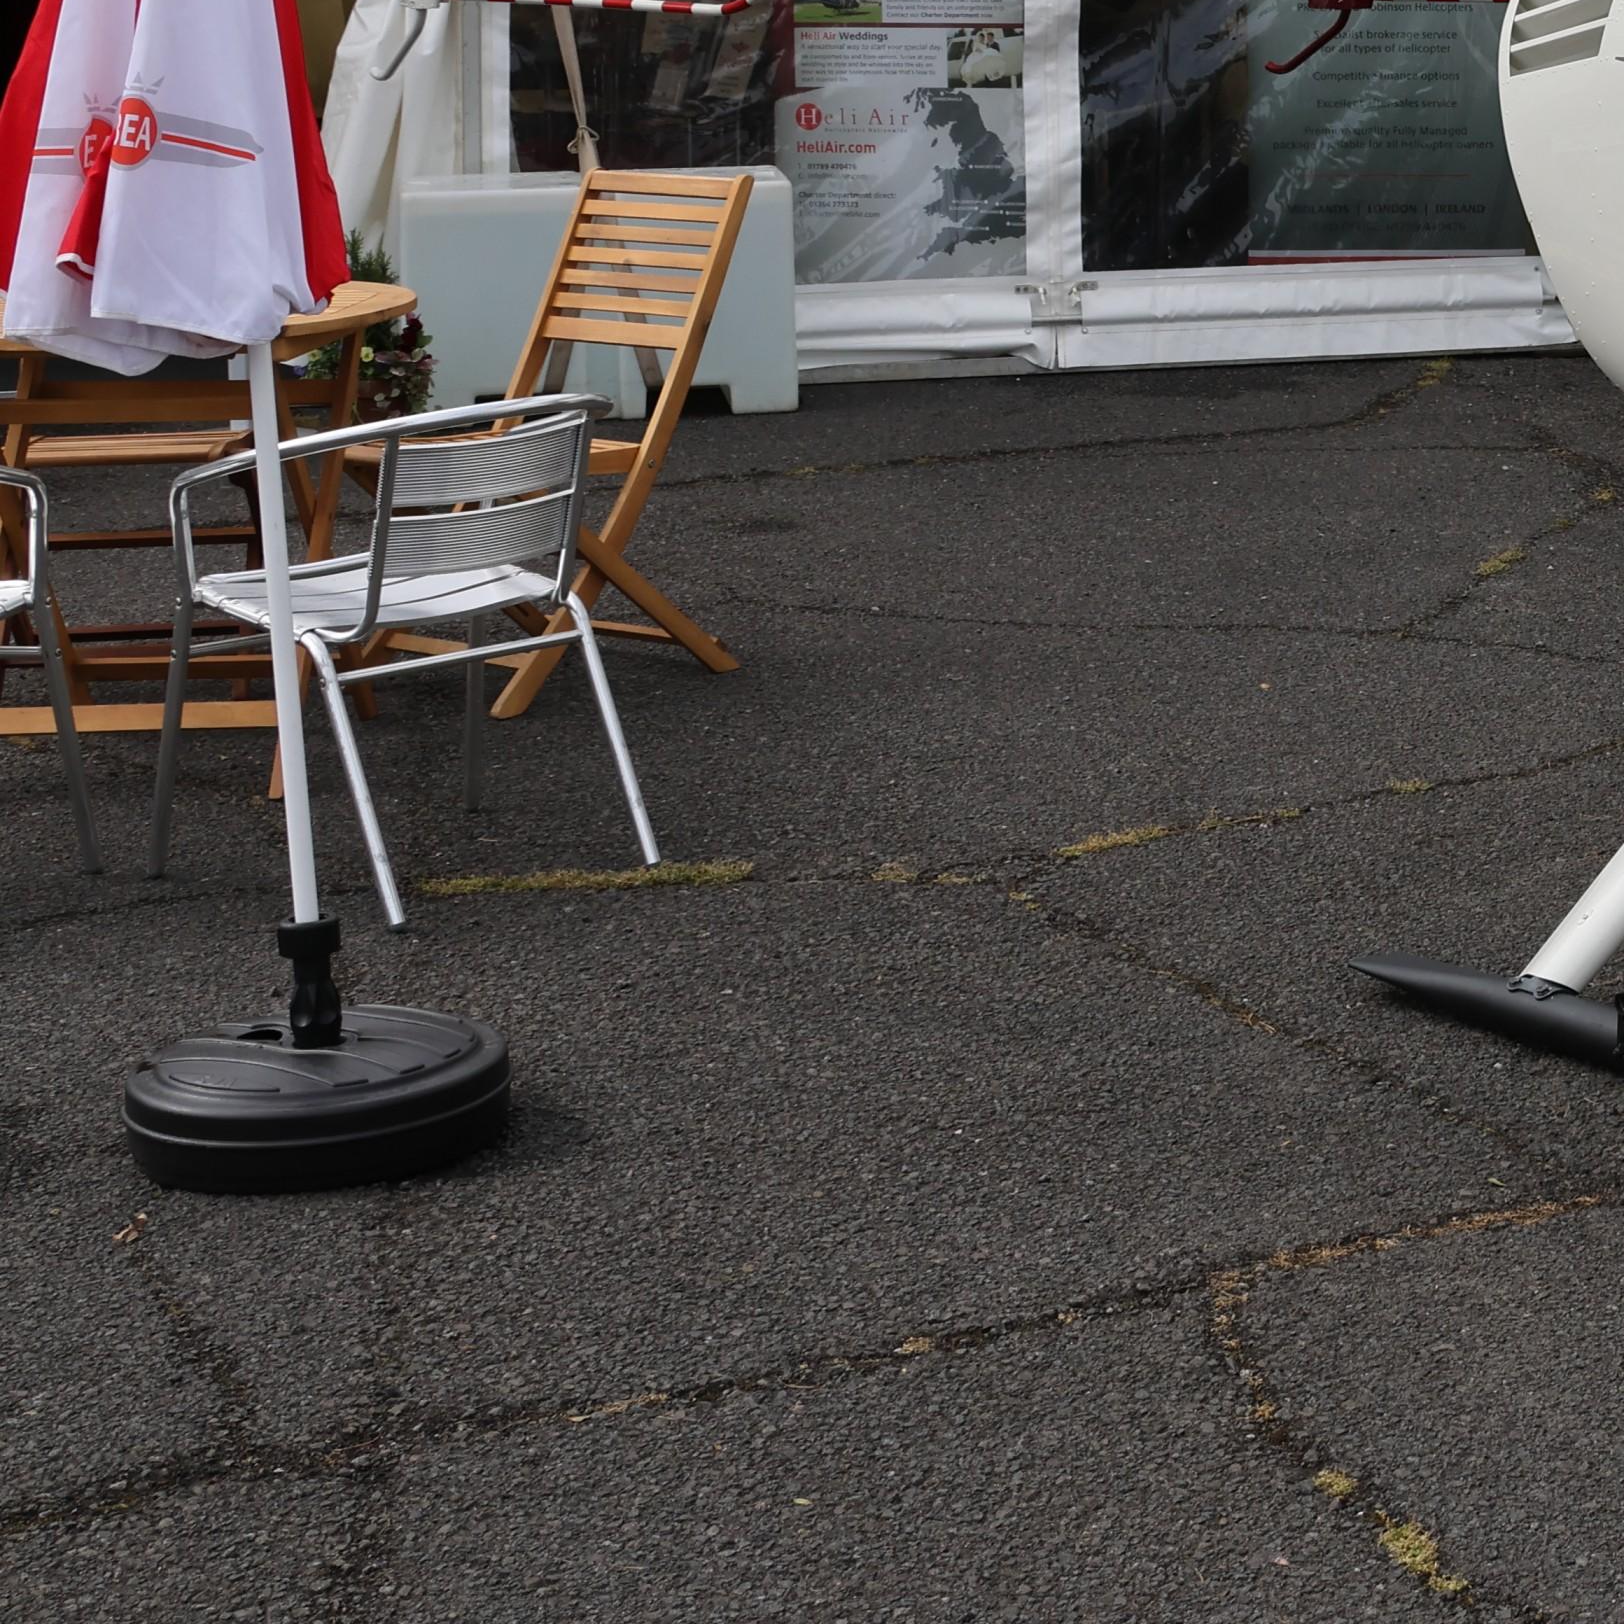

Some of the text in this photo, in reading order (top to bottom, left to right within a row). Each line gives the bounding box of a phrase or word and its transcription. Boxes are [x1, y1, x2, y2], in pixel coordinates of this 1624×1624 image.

[1371, 2, 1413, 12] obinson
[1414, 2, 1473, 14] Helicopters
[800, 31, 888, 42] Heli Air Weddings
[1367, 31, 1420, 42] brokerage
[1422, 31, 1458, 40] service
[1354, 44, 1381, 55] types
[1385, 44, 1395, 53] of
[1316, 98, 1362, 108] Excellen
[797, 106, 909, 127] Heli Air
[796, 140, 876, 153] HeliAir.com
